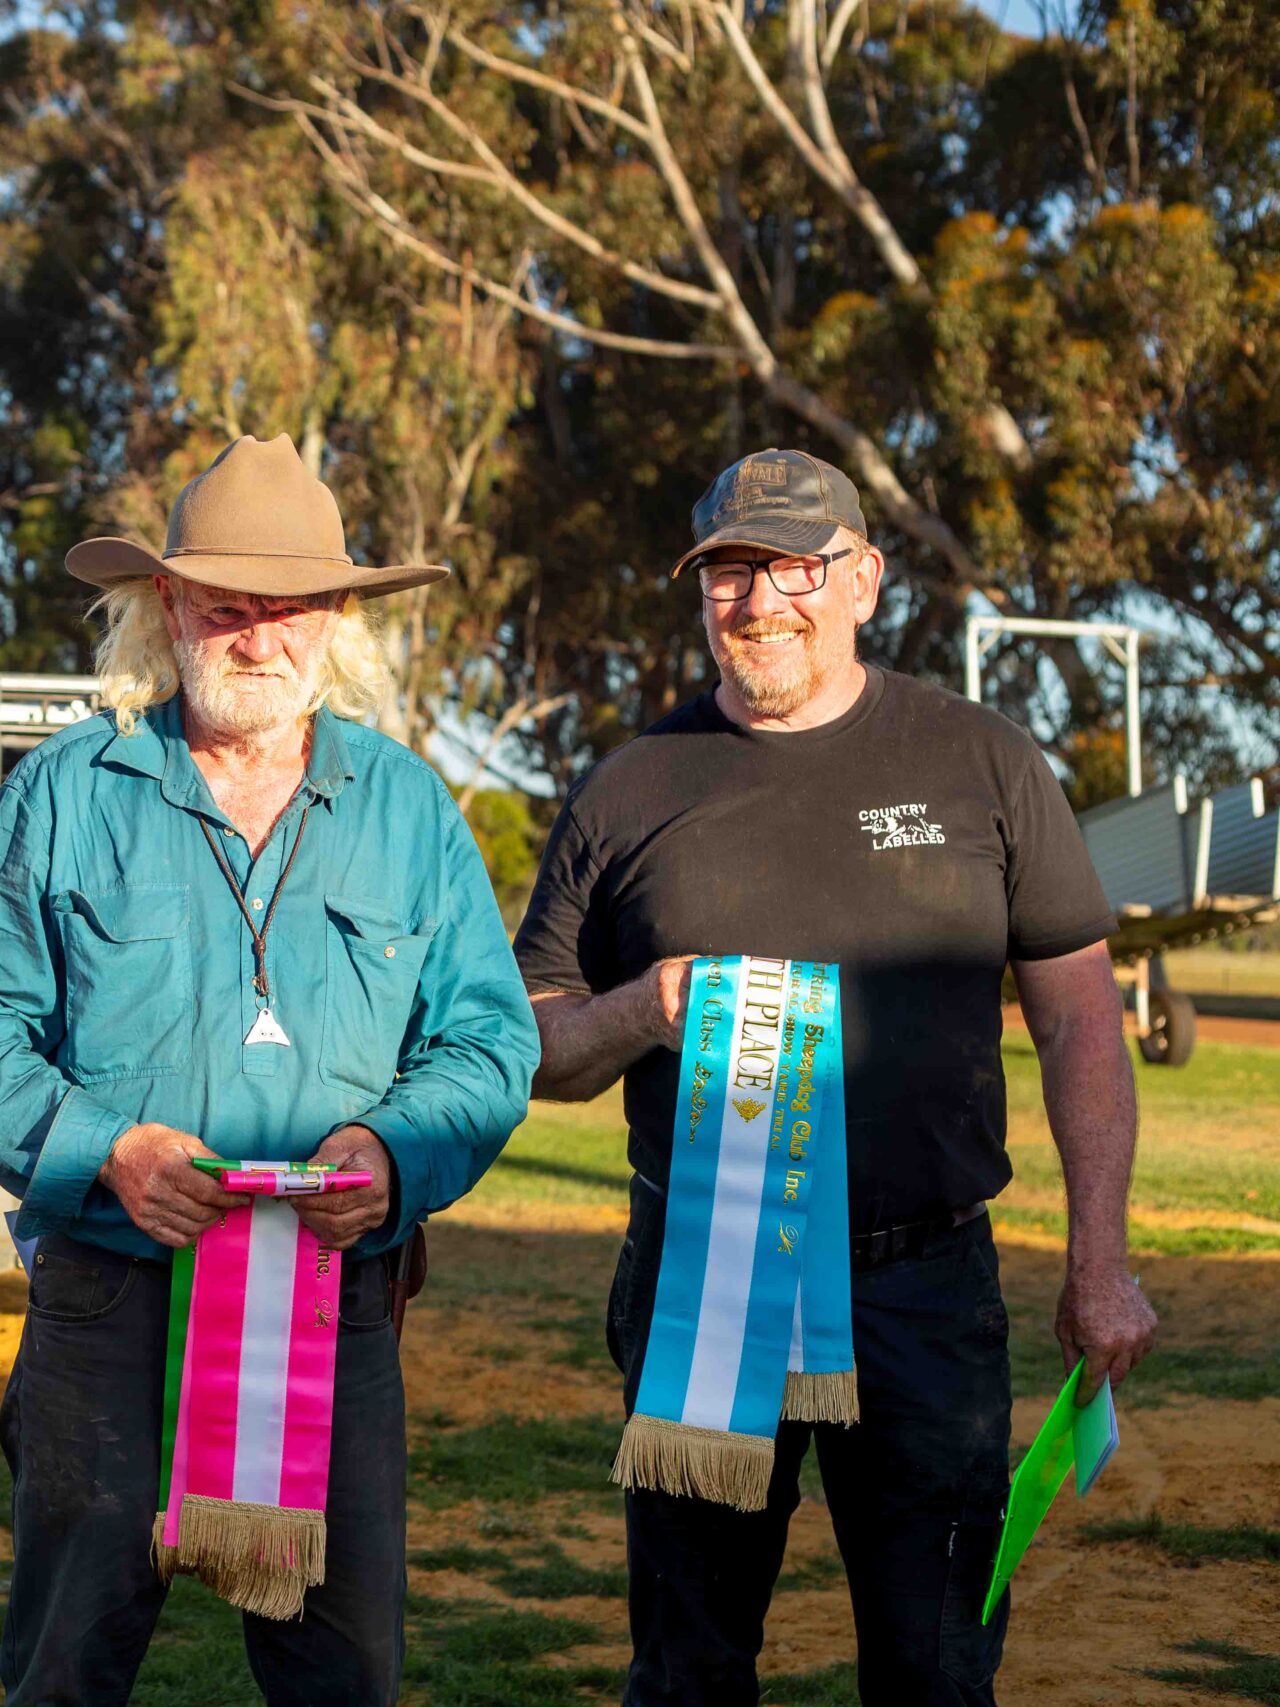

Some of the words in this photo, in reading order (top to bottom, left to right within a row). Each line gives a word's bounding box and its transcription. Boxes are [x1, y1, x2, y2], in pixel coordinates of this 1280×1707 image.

[859, 804, 927, 821] COUNTRY
[873, 833, 945, 850] LABELLED
[698, 998, 724, 1052] Class
[733, 998, 781, 1091] PLACE
[783, 1014, 796, 1058] SHOW
[777, 1063, 791, 1103] YARD
[791, 1022, 825, 1113] Sheepdog
[789, 1120, 812, 1161] Club
[784, 1169, 806, 1206] Inc.
